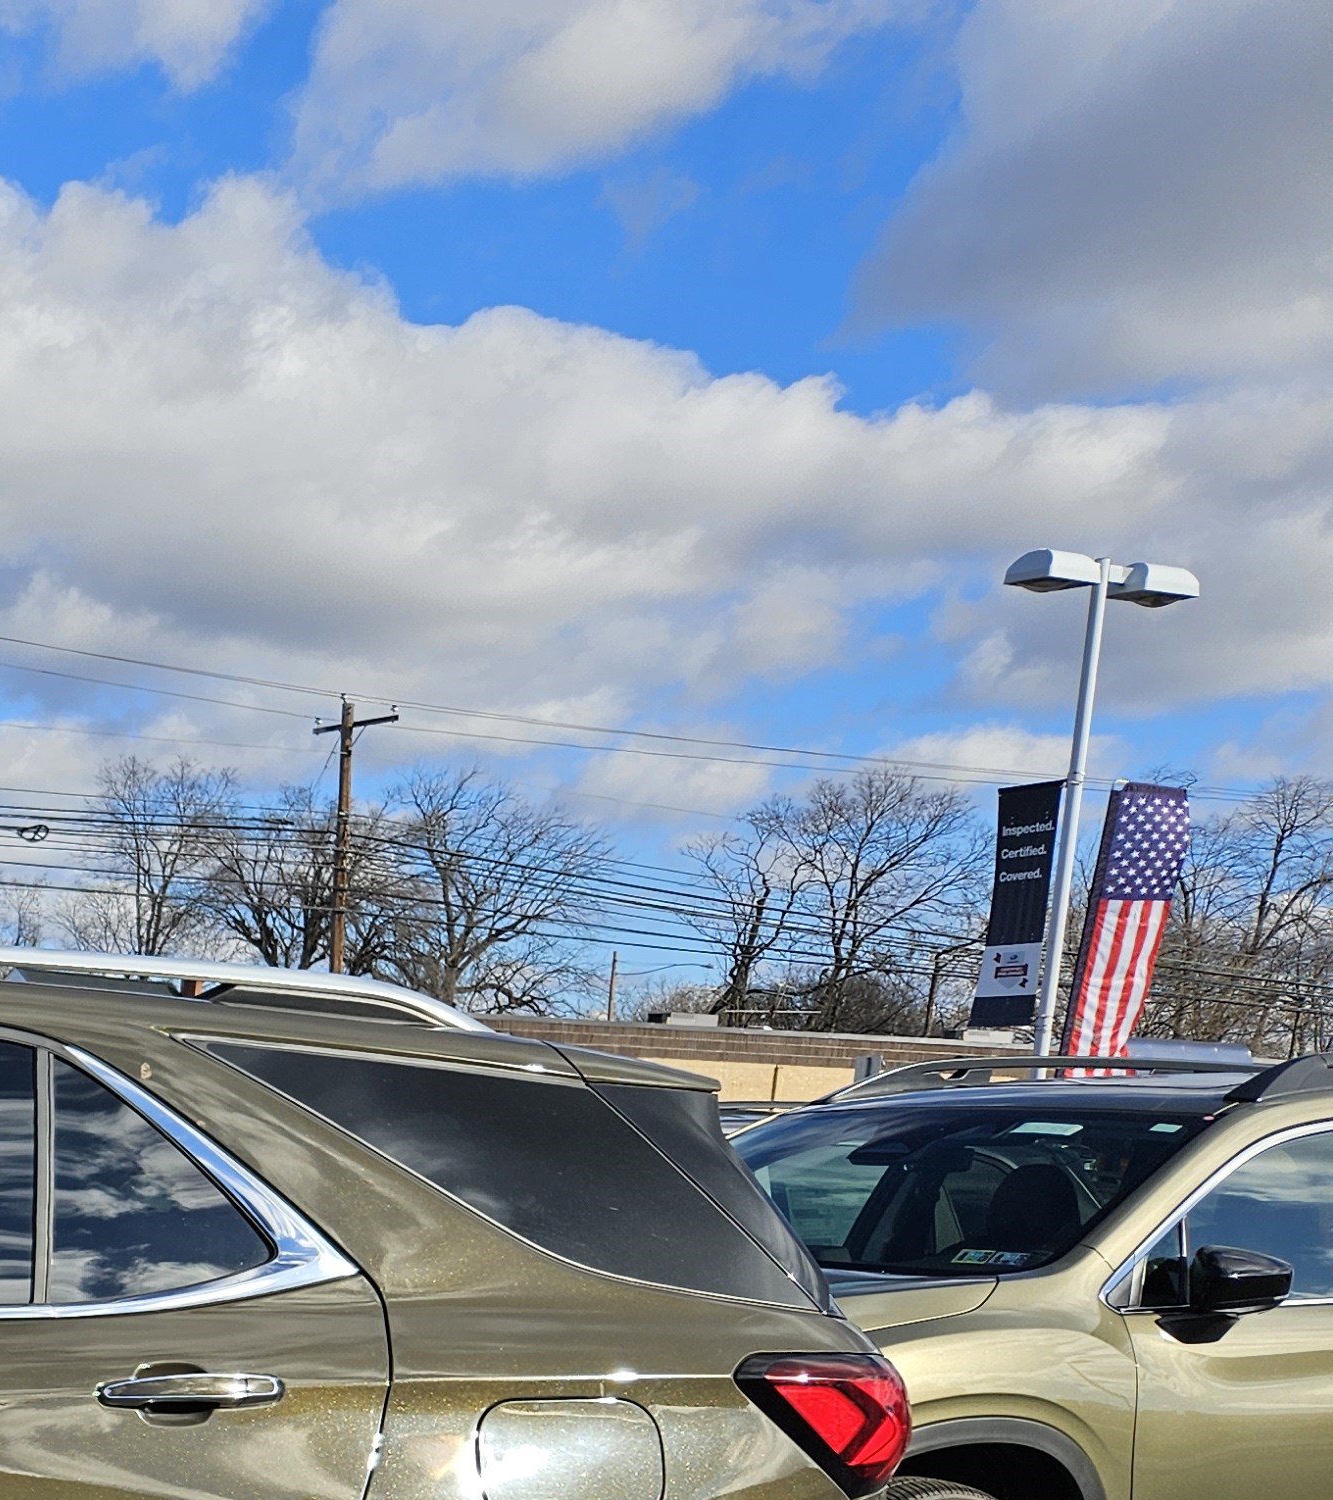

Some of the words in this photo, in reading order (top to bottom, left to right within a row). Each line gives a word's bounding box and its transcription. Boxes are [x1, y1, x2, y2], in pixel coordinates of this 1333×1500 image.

[1001, 820, 1055, 837] Inspected.
[1001, 843, 1048, 860] Certified.
[999, 867, 1043, 882] Covered.
